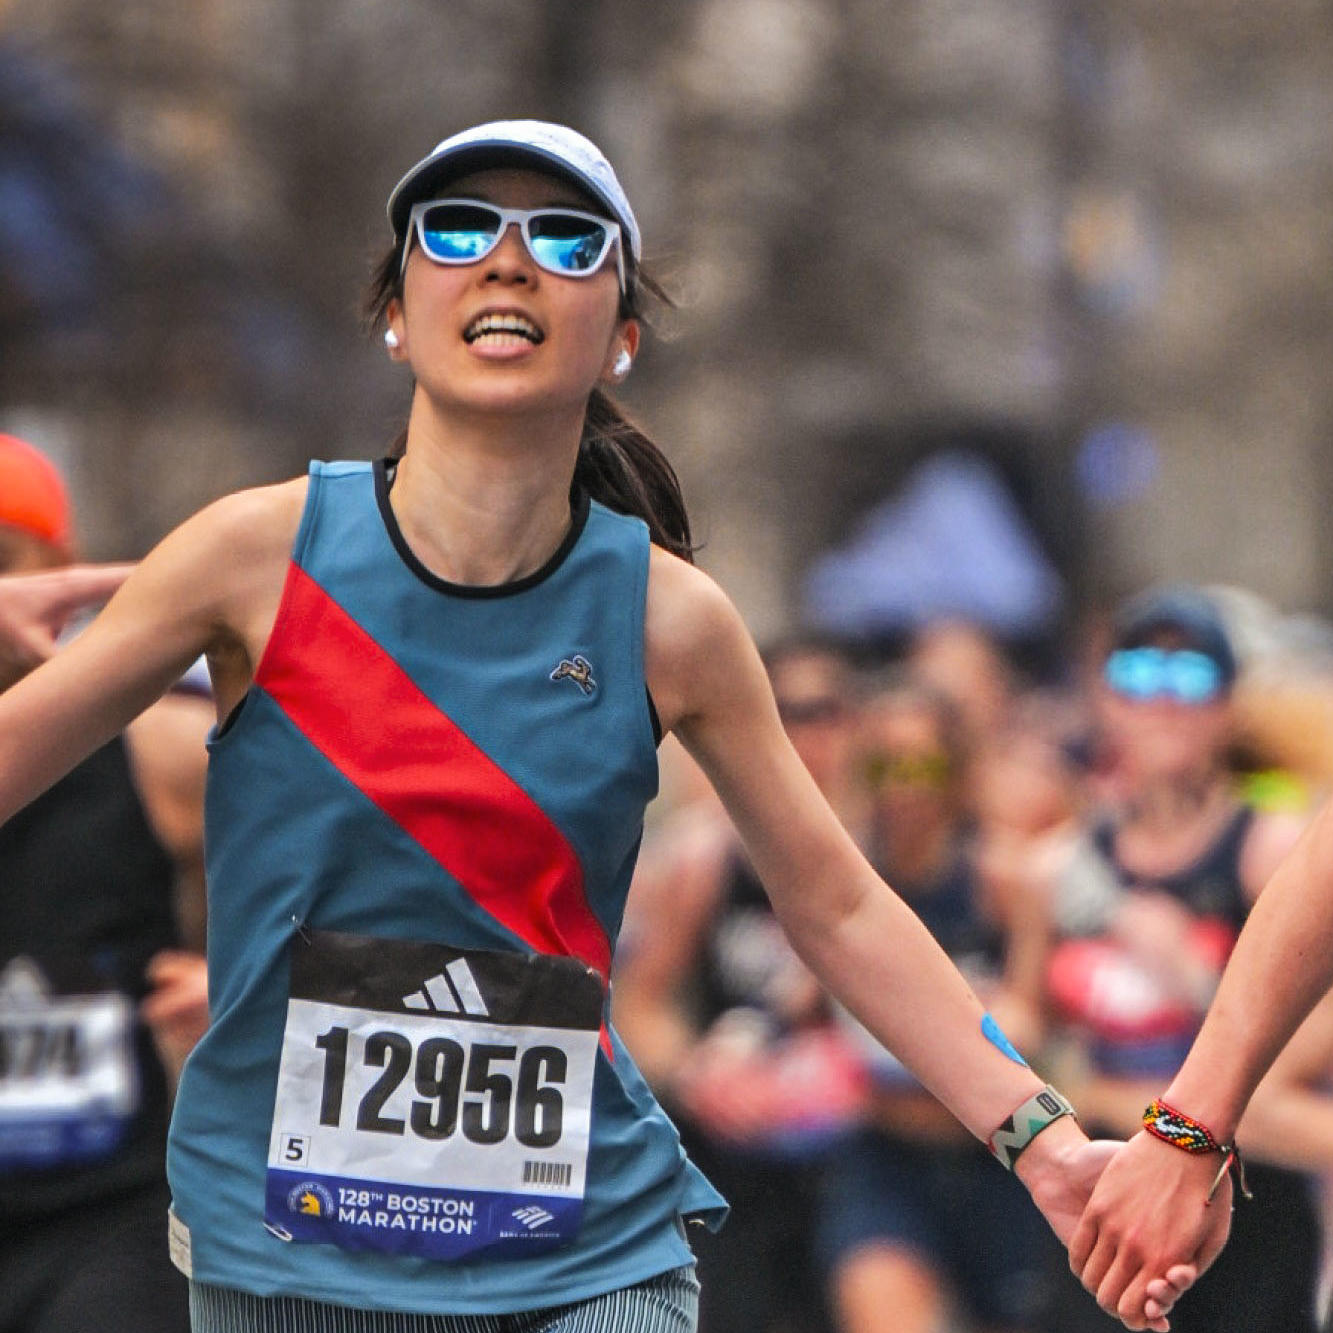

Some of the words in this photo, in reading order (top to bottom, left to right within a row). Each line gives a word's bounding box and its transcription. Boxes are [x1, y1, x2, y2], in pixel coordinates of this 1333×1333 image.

[314, 1025, 568, 1149] 12956
[285, 1138, 303, 1161] 5
[386, 1193, 475, 1217] BOSTON
[338, 1206, 474, 1235] MARATHON
